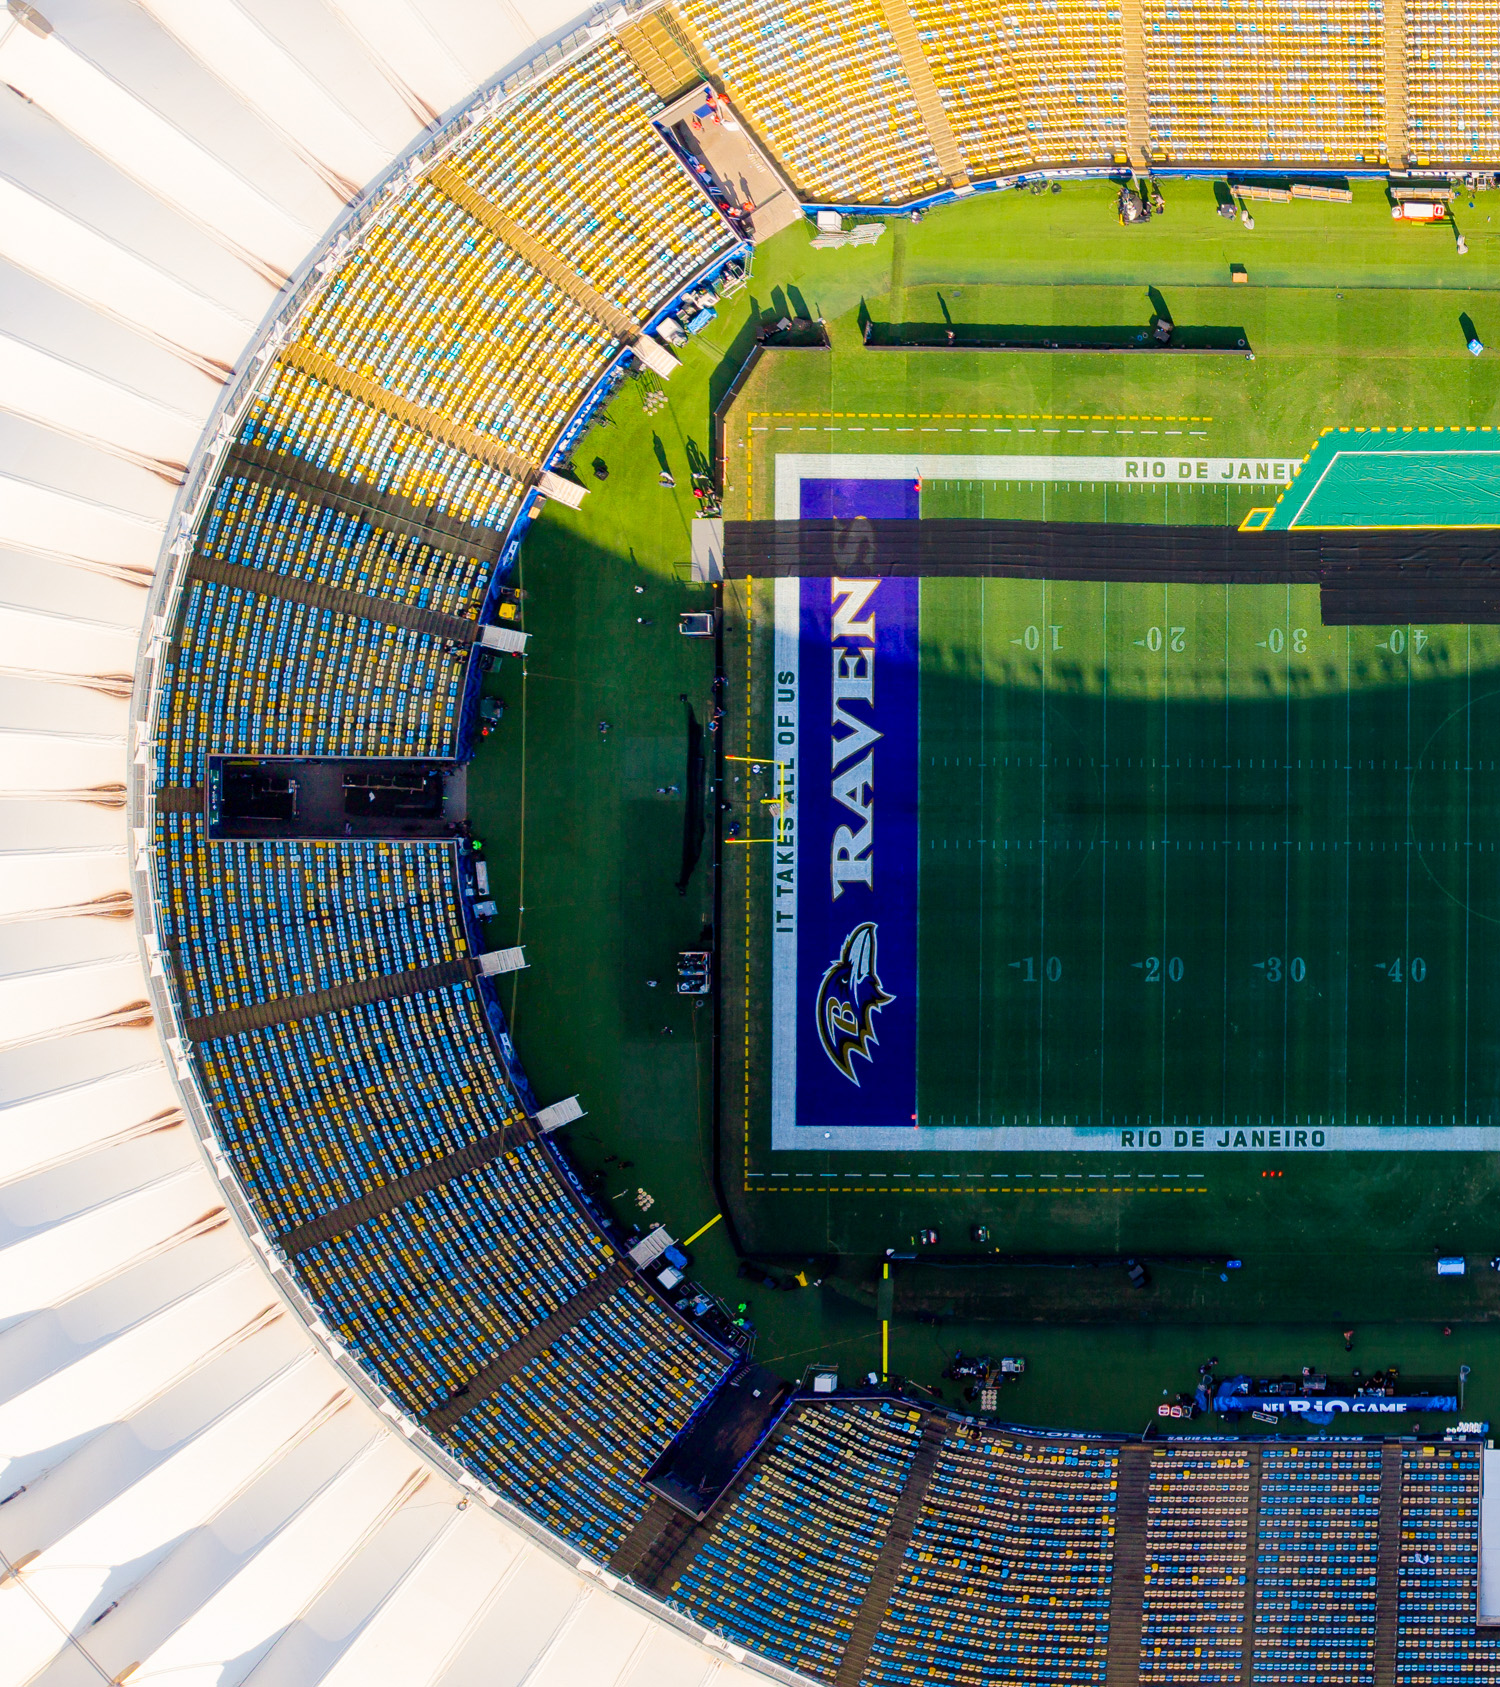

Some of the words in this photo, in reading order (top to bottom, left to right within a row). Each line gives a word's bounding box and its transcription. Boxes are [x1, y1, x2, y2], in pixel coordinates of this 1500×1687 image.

[1125, 461, 1166, 478] RIO
[1178, 462, 1208, 478] DE
[1221, 462, 1295, 480] JANEI
[1024, 625, 1064, 651] 10
[1146, 626, 1186, 652] 20
[1268, 628, 1308, 654] 30
[1388, 629, 1428, 655] 40
[777, 669, 795, 703] US
[777, 714, 795, 745] OF
[777, 757, 795, 805] ALL
[776, 816, 795, 897] TAKES
[776, 910, 794, 934] IT
[1022, 956, 1062, 982] 10
[1145, 956, 1185, 982] 20
[1266, 956, 1306, 982] 30
[1387, 957, 1427, 982] 40
[825, 996, 859, 1048] B
[1120, 1130, 1162, 1148] RIO
[1174, 1130, 1205, 1148] DE
[1216, 1130, 1326, 1148] JANEIRO
[1352, 1403, 1407, 1412] GAME
